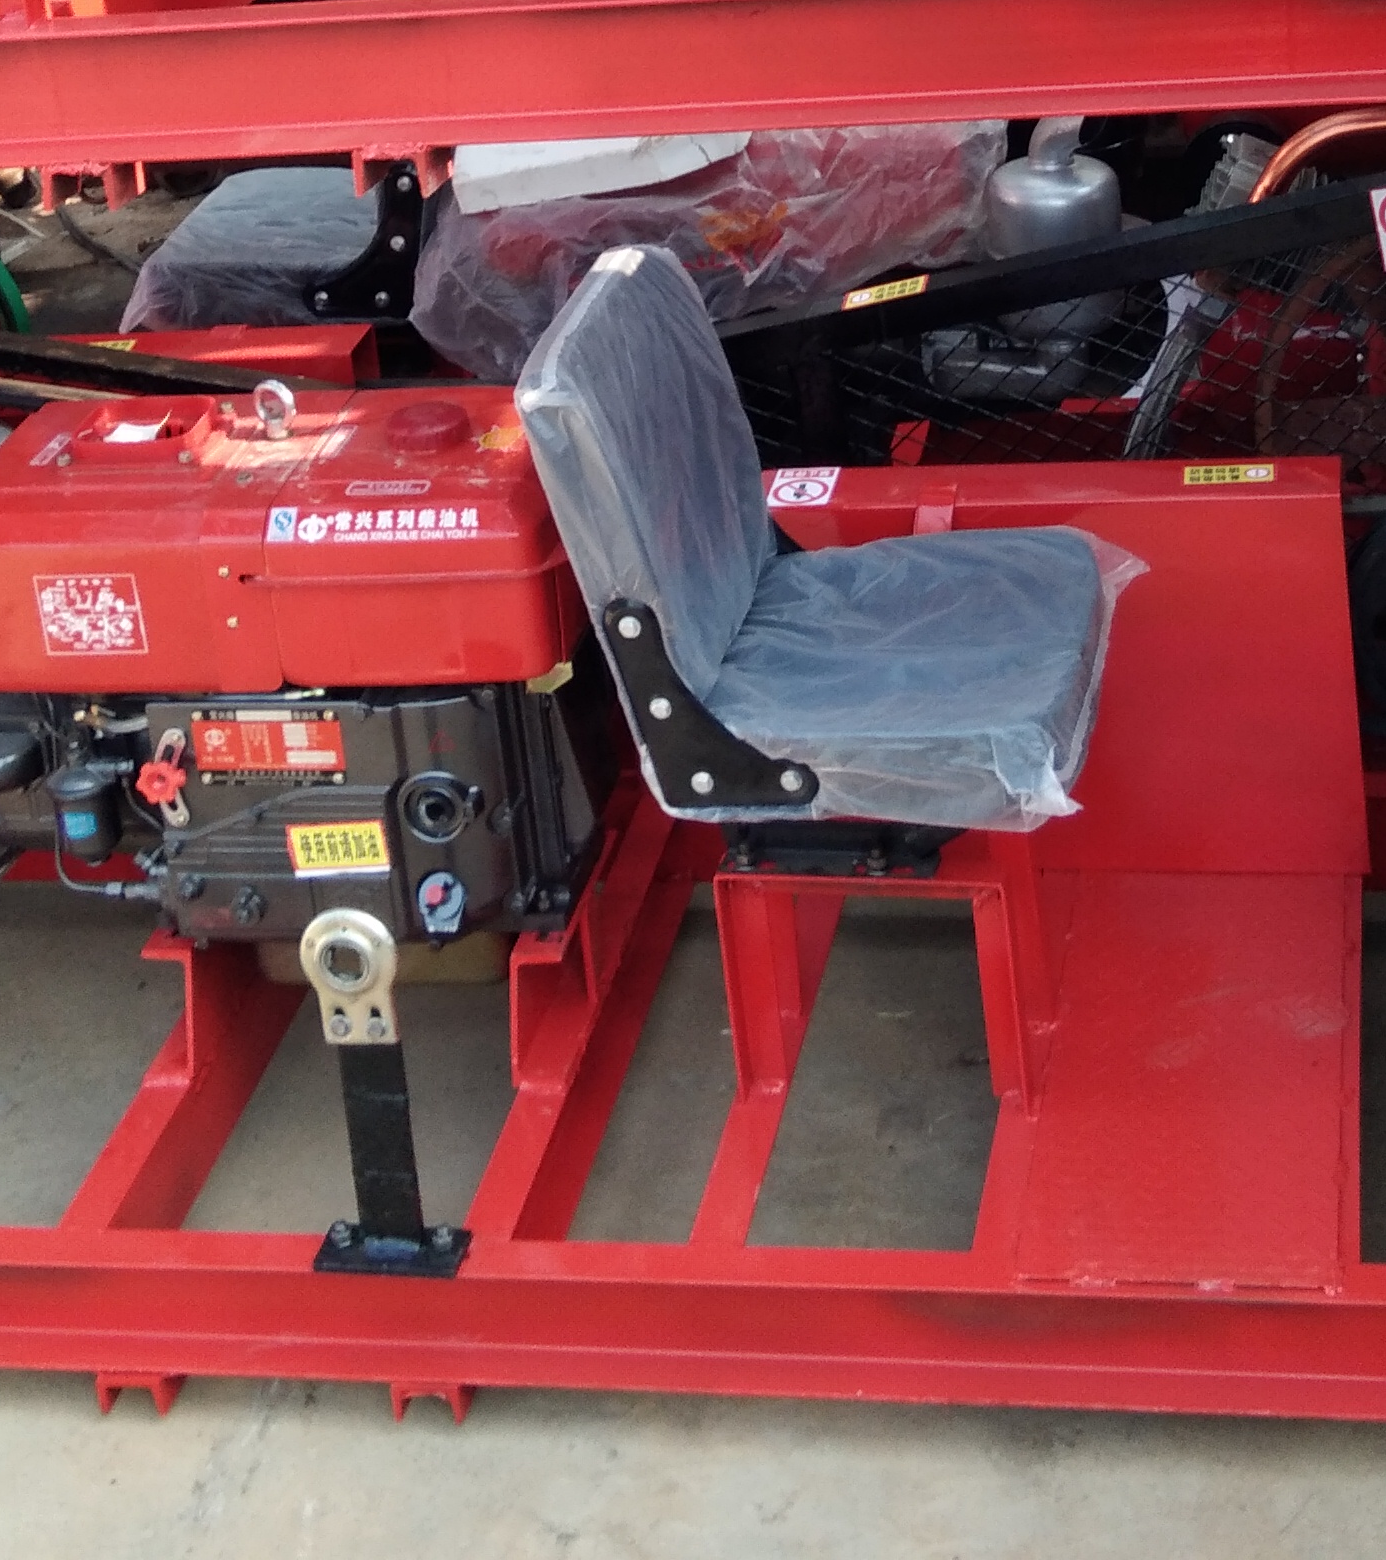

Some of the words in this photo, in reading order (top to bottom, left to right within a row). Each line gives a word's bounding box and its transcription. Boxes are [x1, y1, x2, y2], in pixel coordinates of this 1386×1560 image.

[334, 508, 479, 531] 常兴系列柴油机
[299, 830, 381, 864] 使用前请加油
